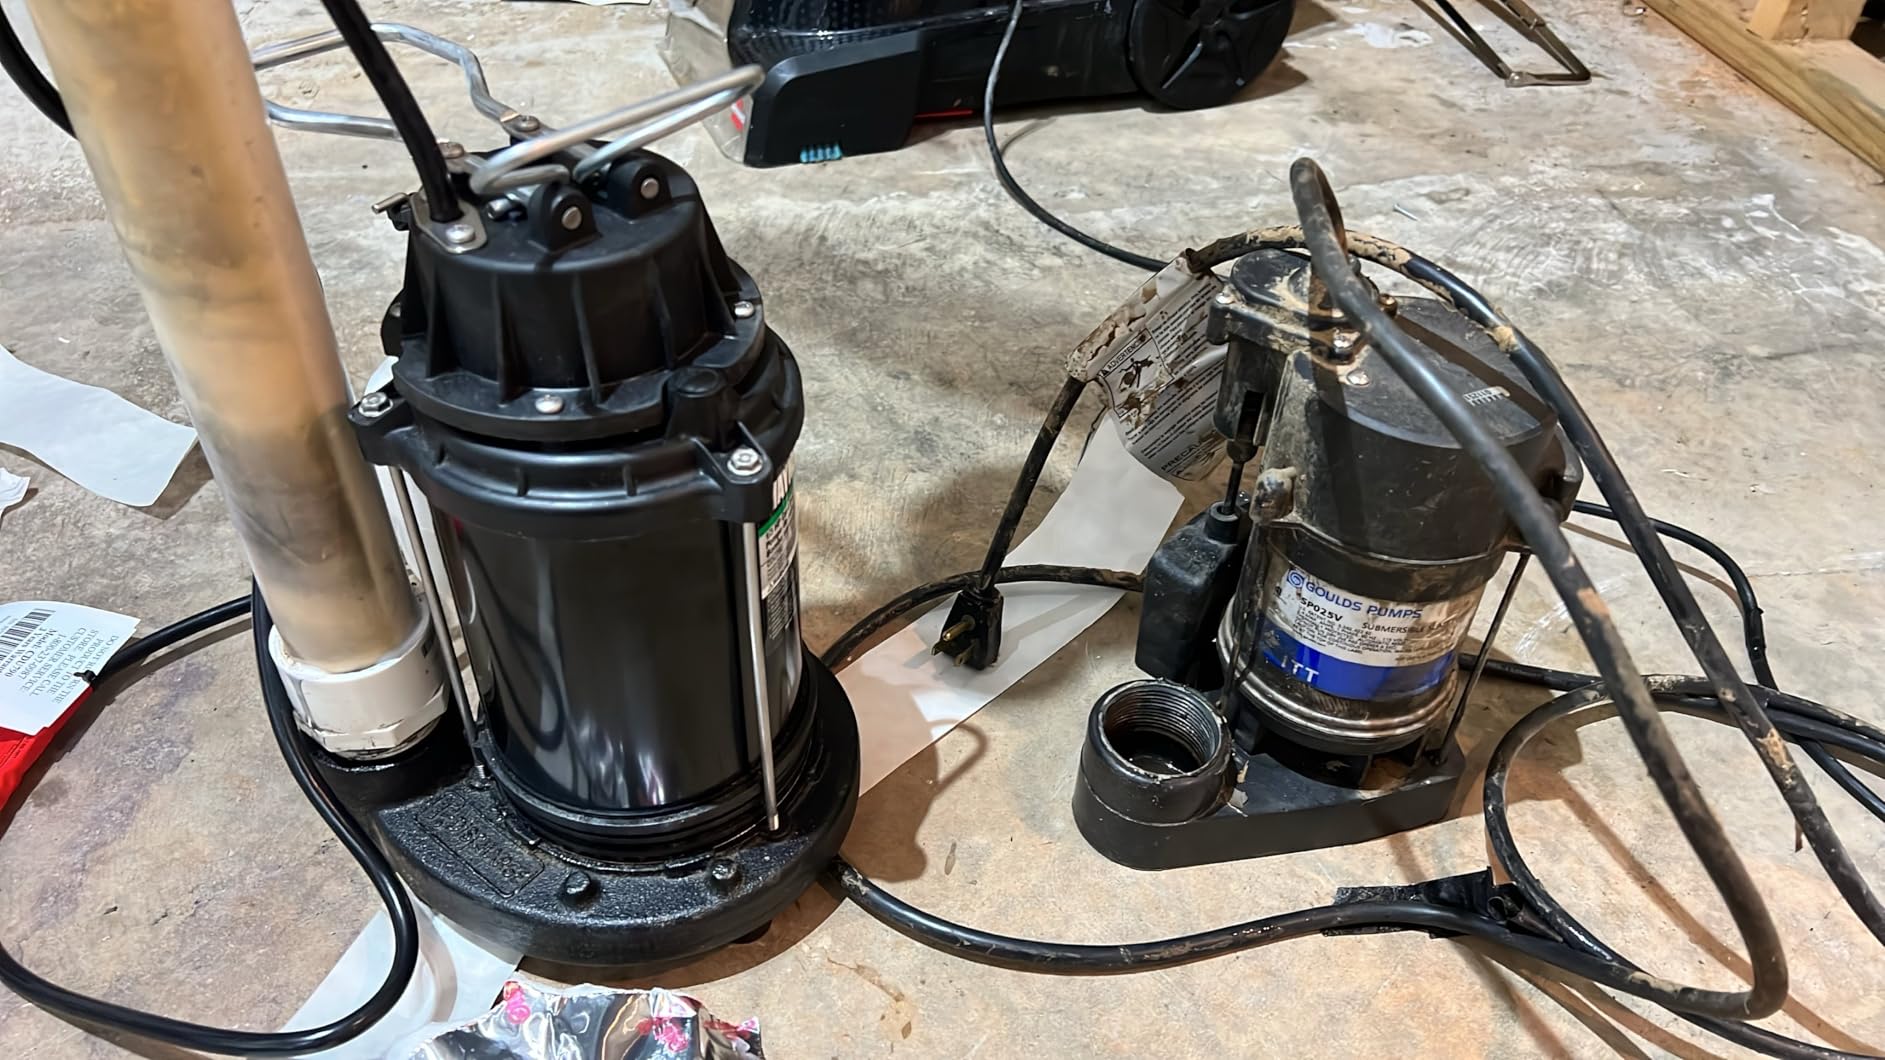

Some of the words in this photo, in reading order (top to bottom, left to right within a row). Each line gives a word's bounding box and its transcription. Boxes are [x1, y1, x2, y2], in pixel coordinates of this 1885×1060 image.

[1106, 333, 1146, 371] ADVERTENC
[1300, 597, 1344, 622] SP025V
[1305, 581, 1363, 612] GOULDS
[1366, 605, 1423, 619] PUMPS
[20, 631, 42, 648] Years
[47, 626, 88, 663] CUSTOMER
[104, 634, 119, 646] DO
[5, 650, 35, 678] CDU790
[70, 637, 104, 670] PRODUCT
[90, 646, 108, 660] NOT
[20, 663, 53, 691] SERVICE
[46, 653, 76, 679] PLEASE
[28, 678, 52, 698] CALL
[45, 680, 65, 695] THE
[51, 689, 70, 704] THE
